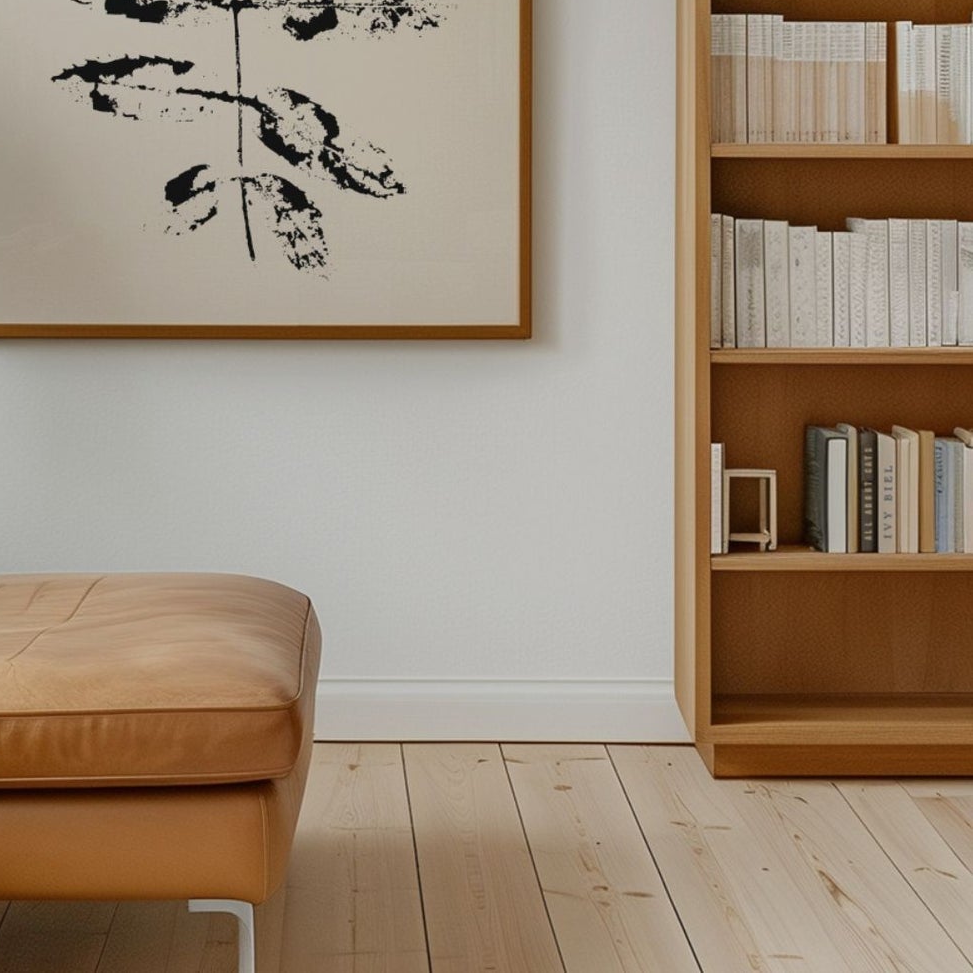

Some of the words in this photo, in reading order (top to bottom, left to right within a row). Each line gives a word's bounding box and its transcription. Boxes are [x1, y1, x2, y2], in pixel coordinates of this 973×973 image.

[883, 465, 894, 502] BIEL
[863, 522, 873, 541] ALL
[883, 511, 893, 539] IVY
